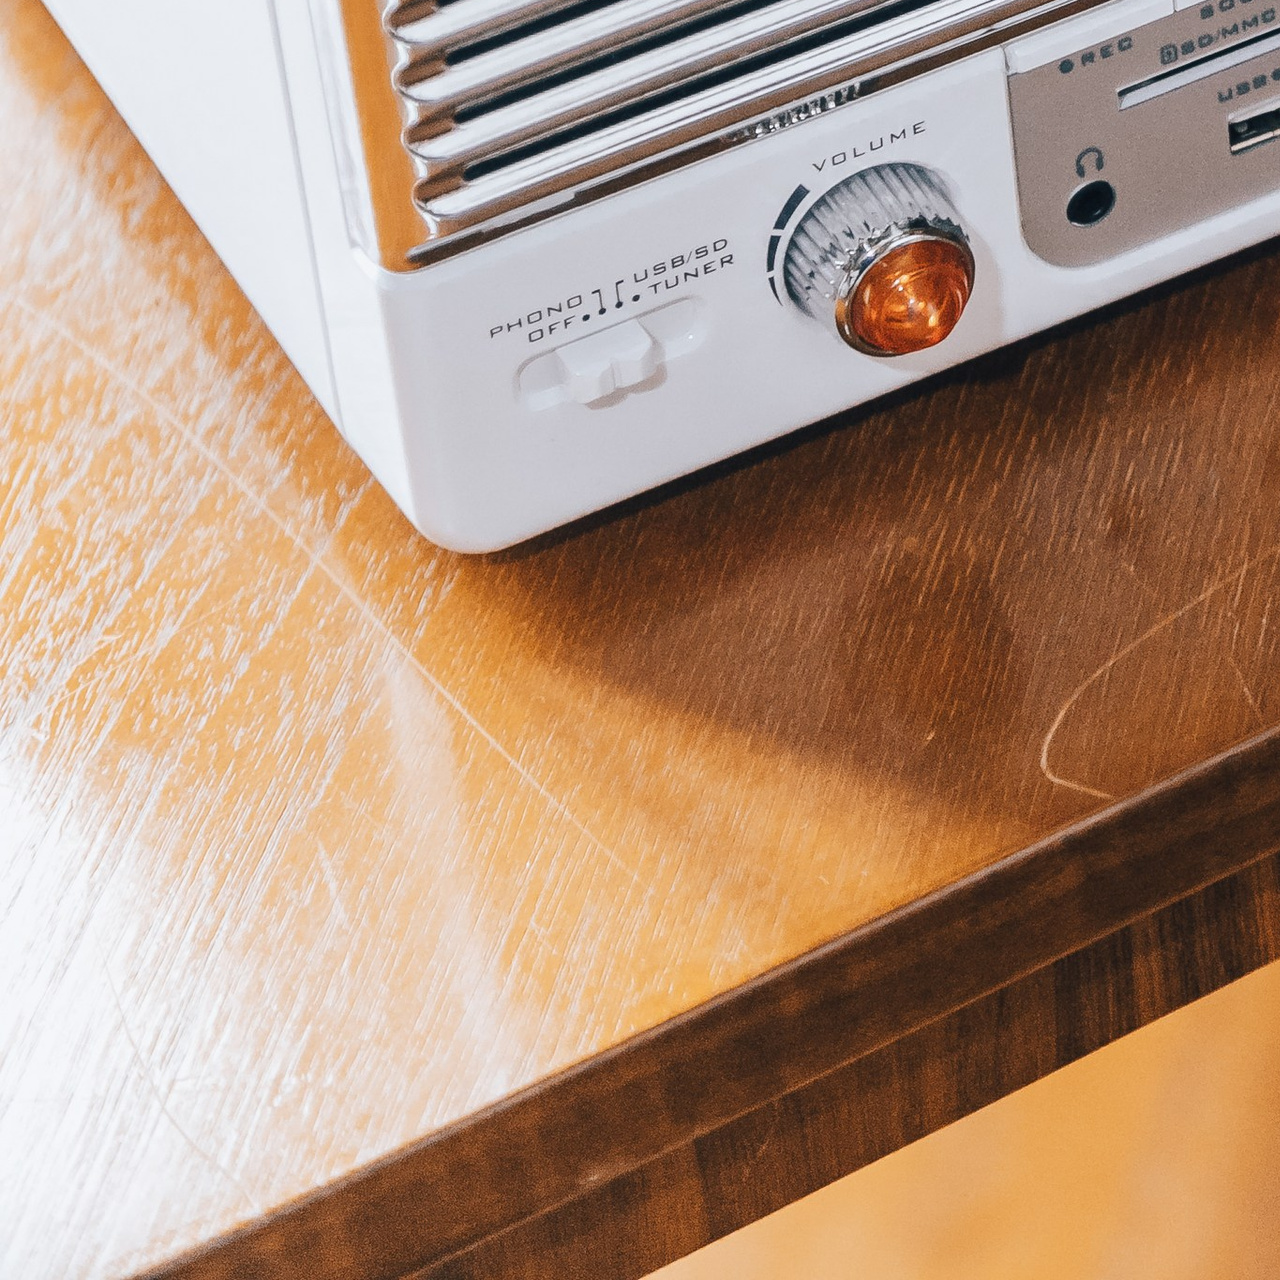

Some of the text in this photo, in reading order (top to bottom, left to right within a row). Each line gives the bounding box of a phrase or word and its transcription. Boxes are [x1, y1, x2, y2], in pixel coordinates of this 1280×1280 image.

[1080, 37, 1134, 66] REC
[1217, 73, 1267, 103] USB
[811, 120, 926, 172] VOLUME
[633, 238, 729, 283] USB/SD
[648, 253, 735, 296] TUNER
[489, 294, 583, 339] PHONO
[527, 314, 578, 343] OFF
